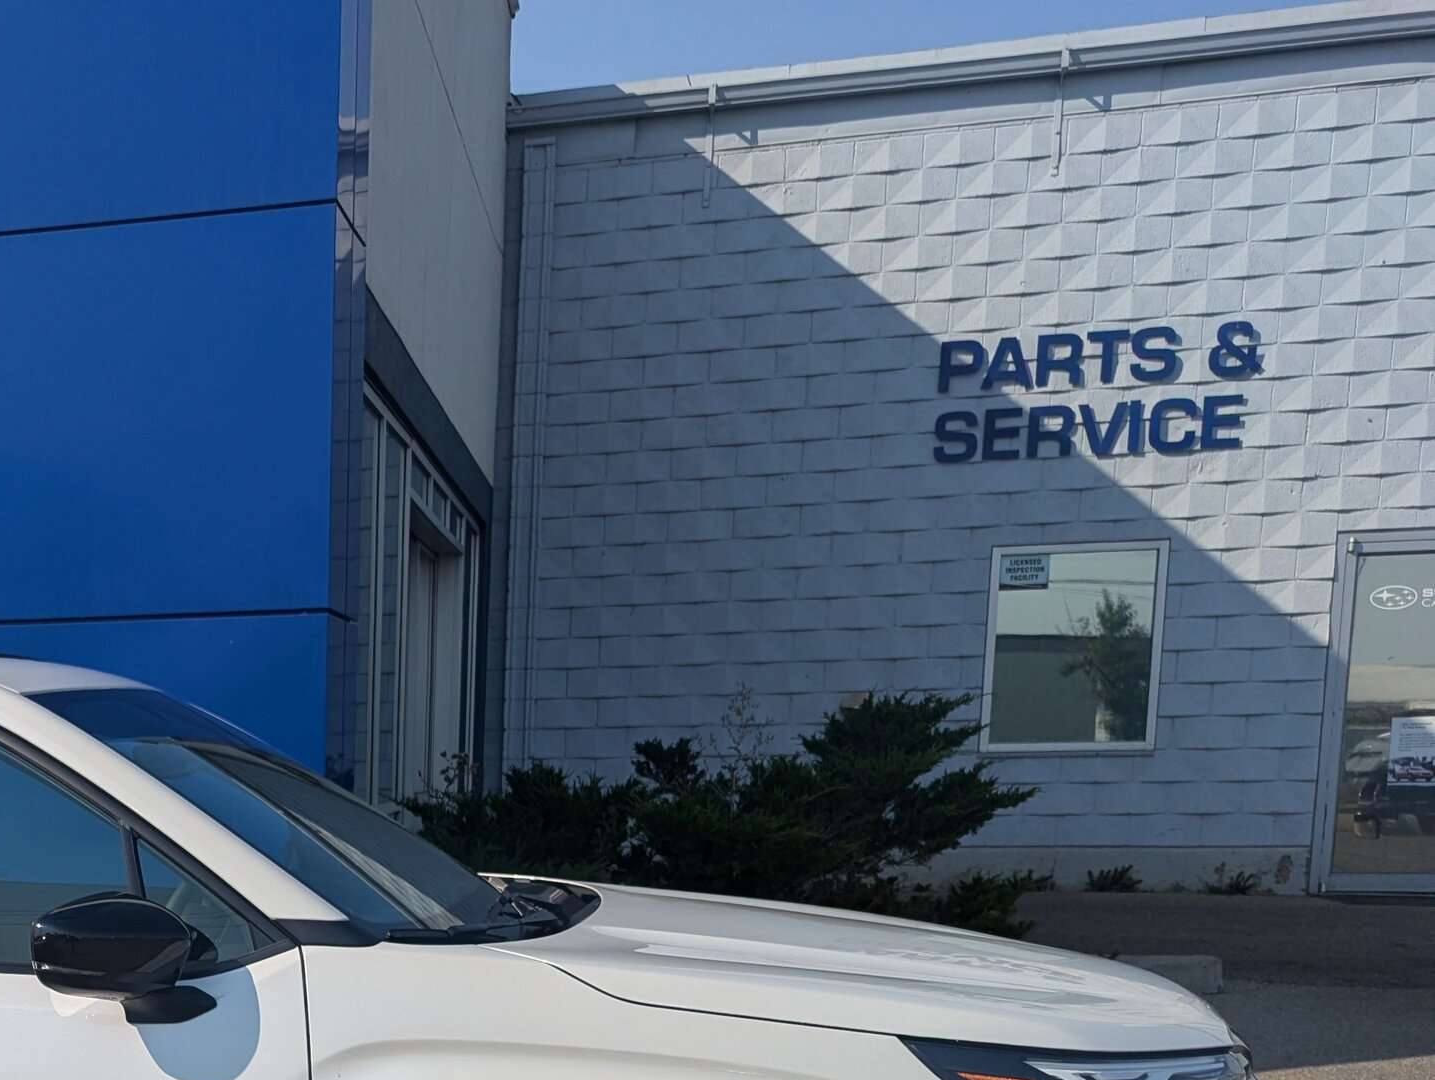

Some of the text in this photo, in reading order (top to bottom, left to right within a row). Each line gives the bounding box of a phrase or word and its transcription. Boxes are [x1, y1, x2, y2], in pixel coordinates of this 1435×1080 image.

[937, 319, 1264, 394] PARTS &
[933, 393, 1245, 464] SERVICE
[1005, 565, 1045, 574] INSPECTION
[1009, 558, 1042, 566] LICENSED
